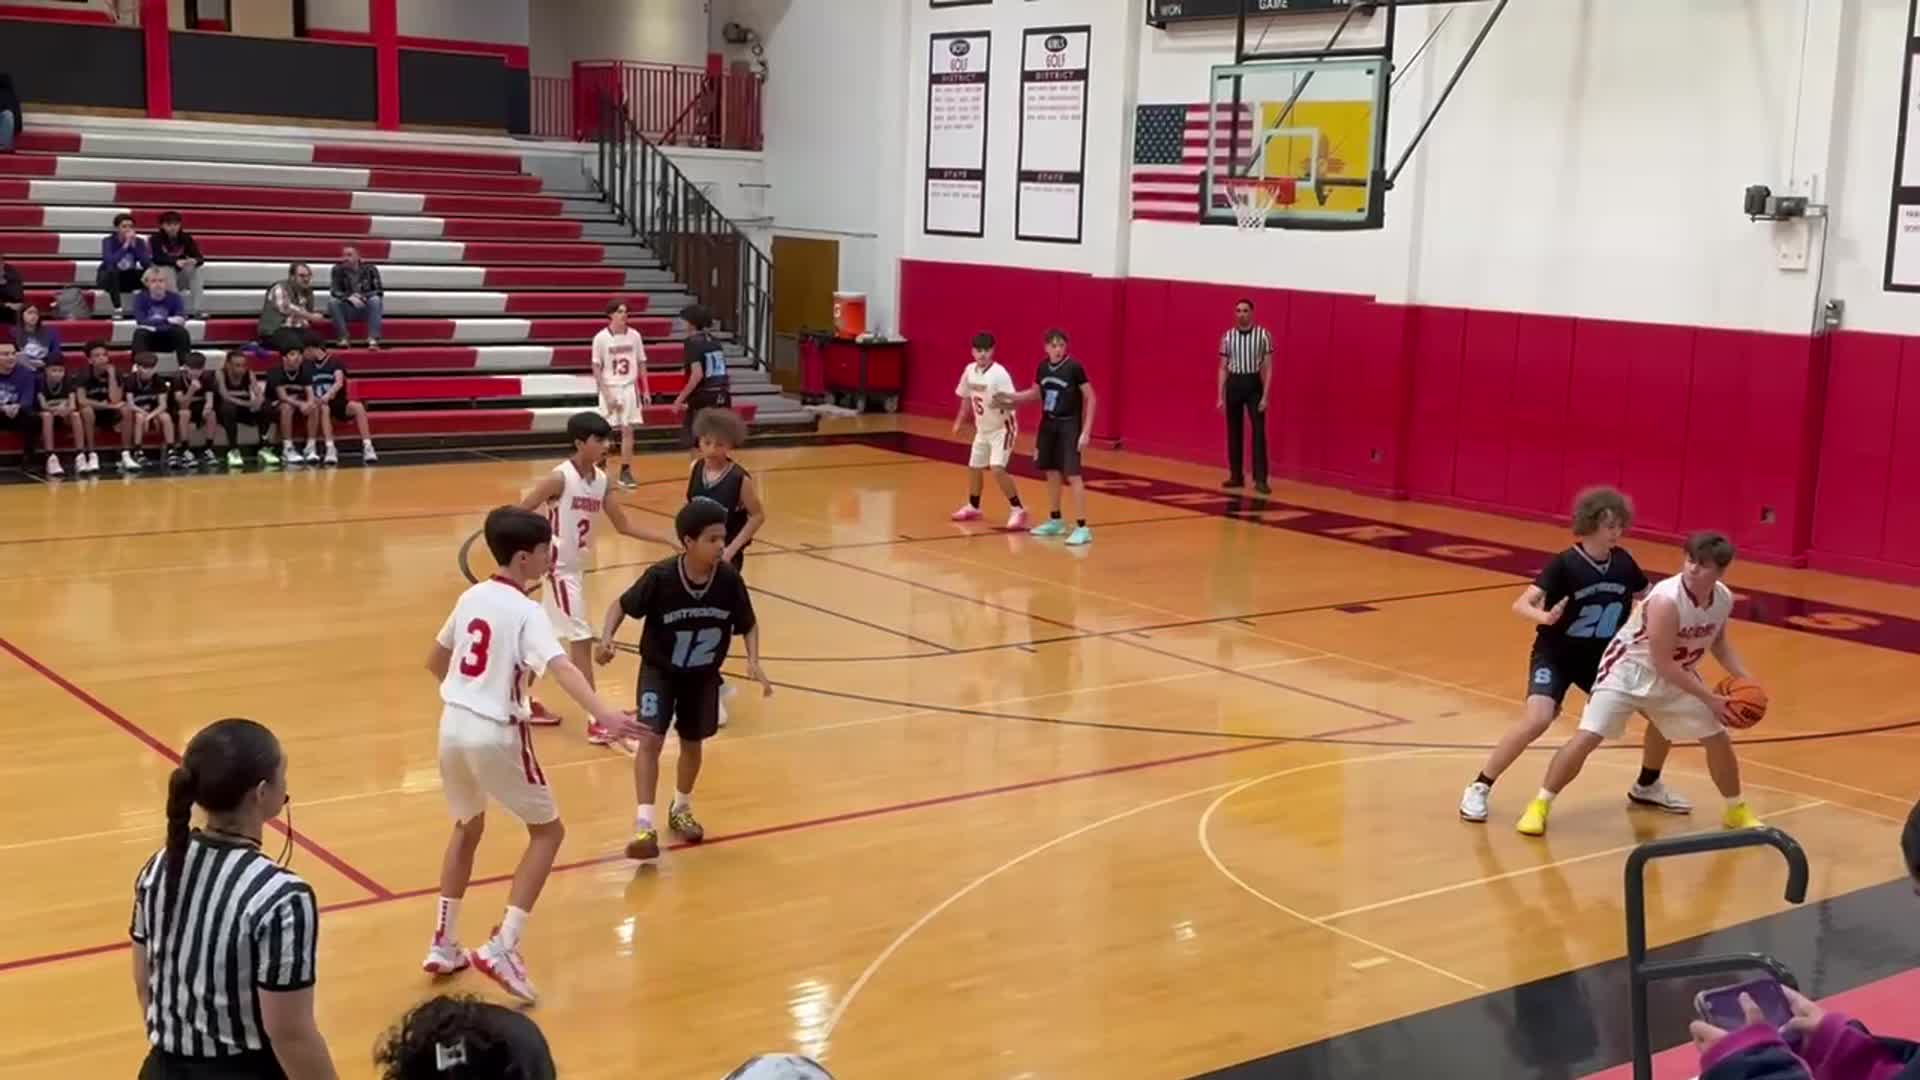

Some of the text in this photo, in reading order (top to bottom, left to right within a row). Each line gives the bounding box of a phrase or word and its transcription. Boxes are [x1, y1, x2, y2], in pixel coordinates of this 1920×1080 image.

[1259, 0, 1288, 9] GAME
[950, 58, 968, 71] GOLF
[1046, 54, 1065, 67] GOLF
[942, 74, 976, 82] DISTRICT
[1035, 71, 1074, 80] DISTRICT
[944, 169, 968, 179] STATE
[1037, 173, 1064, 181] STATE
[612, 358, 629, 375] 13
[577, 518, 590, 548] 2
[460, 617, 491, 677] 3
[671, 626, 722, 668] 12
[1535, 668, 1552, 684] S
